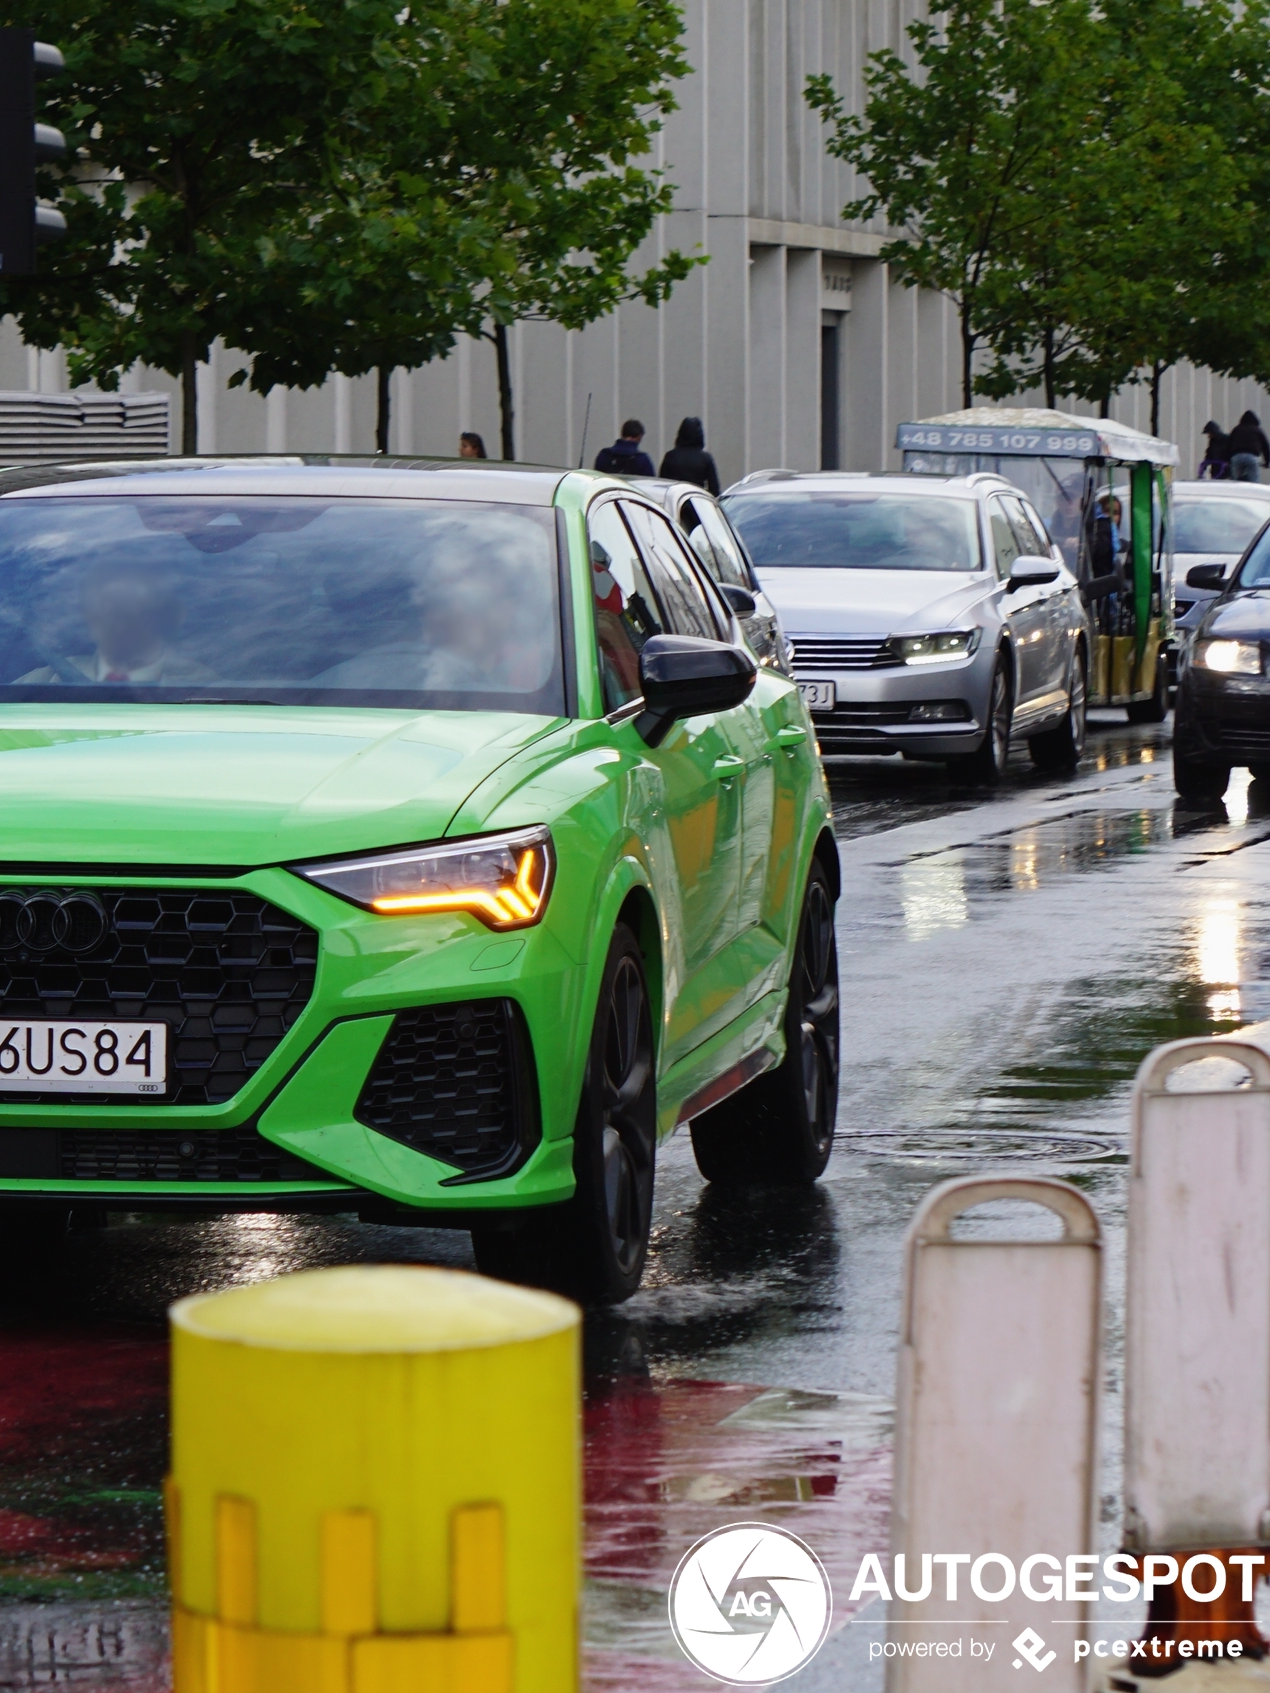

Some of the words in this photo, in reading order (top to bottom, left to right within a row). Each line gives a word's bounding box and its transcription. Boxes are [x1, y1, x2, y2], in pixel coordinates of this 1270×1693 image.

[901, 431, 942, 449] +48
[948, 432, 993, 447] 785
[999, 434, 1041, 449] 107
[1046, 436, 1093, 451] 999
